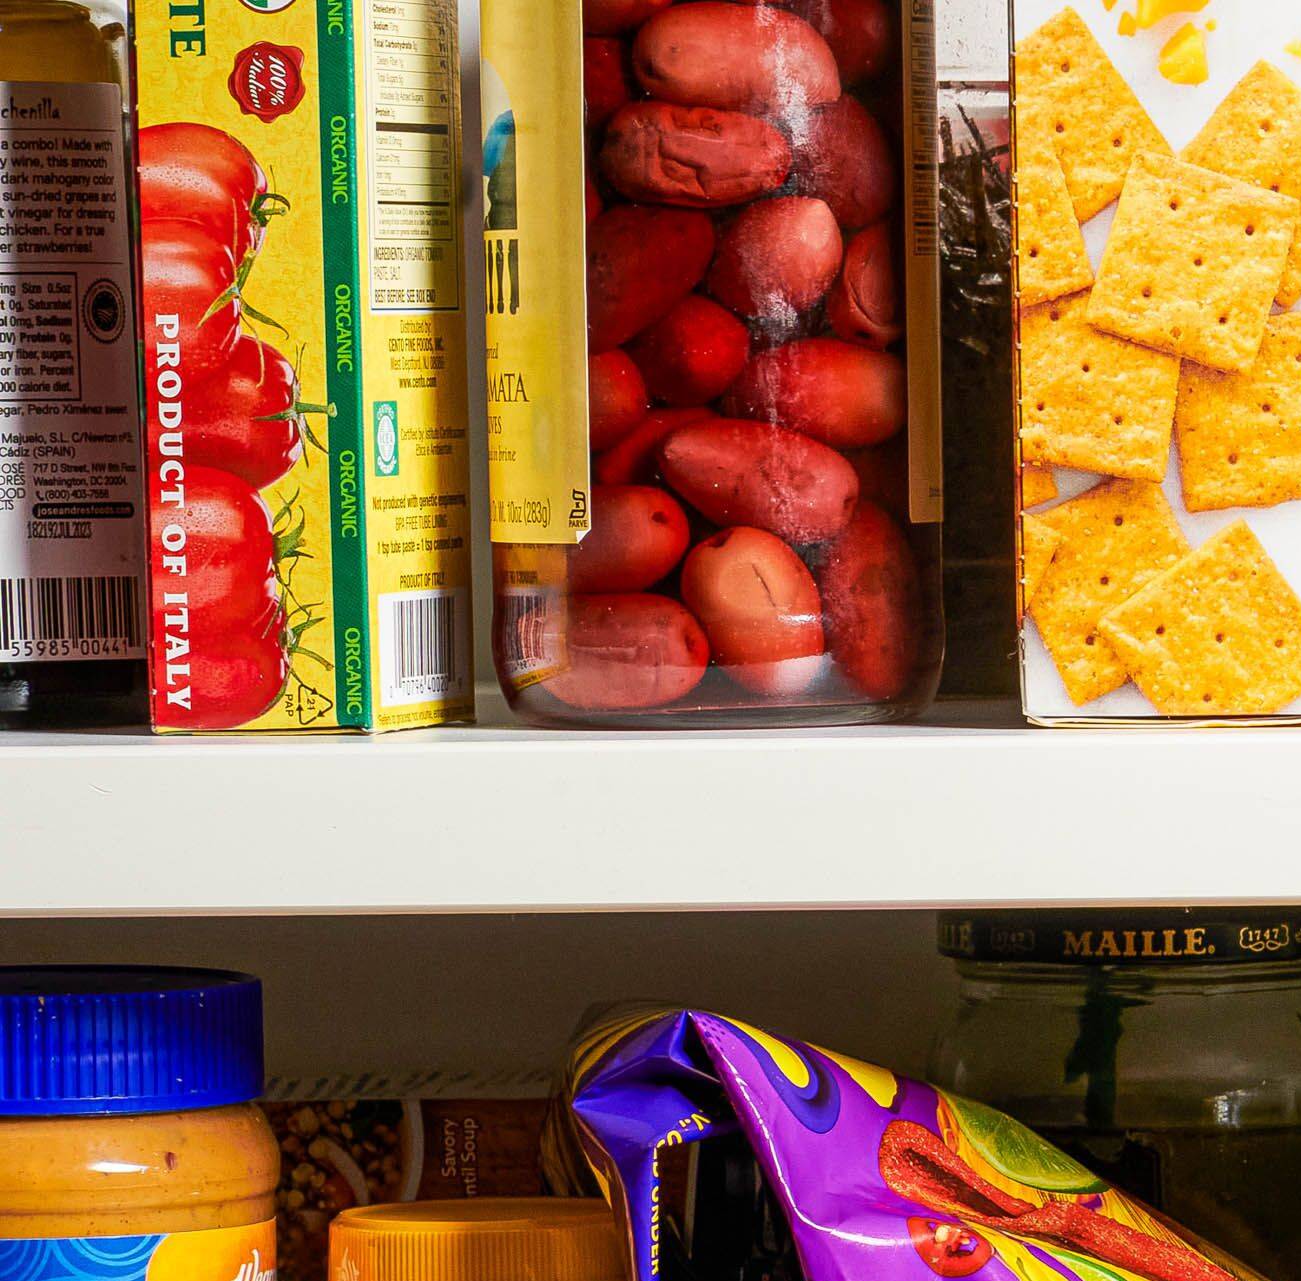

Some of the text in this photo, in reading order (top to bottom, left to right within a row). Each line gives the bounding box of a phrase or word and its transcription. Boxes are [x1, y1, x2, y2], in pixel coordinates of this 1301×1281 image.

[249, 51, 264, 109] Italian
[269, 54, 287, 107] 100%
[33, 173, 90, 188] mahogany
[330, 116, 348, 204] ORGANIC
[8, 208, 54, 221] vinegar
[334, 284, 353, 373] ORGANIC
[155, 313, 192, 711] PRODUCT OF ITALY
[339, 450, 357, 538] ORGANIC
[568, 519, 587, 528] PARVE
[11, 640, 127, 656] 55985 00441
[344, 627, 362, 715] ORGANIC
[284, 694, 293, 717] PAP
